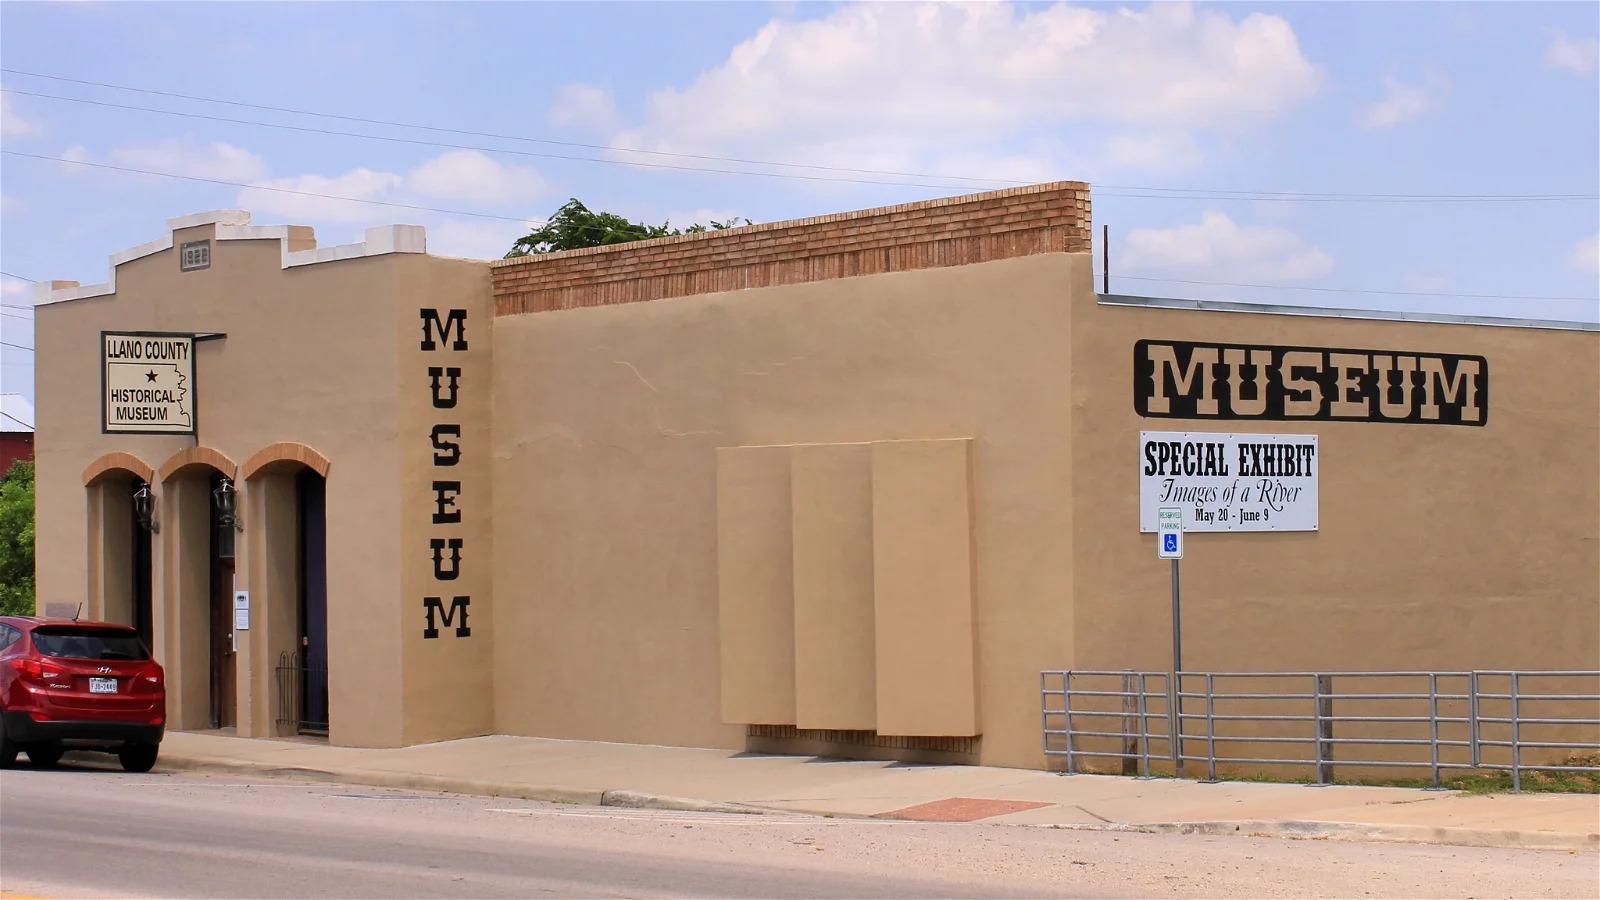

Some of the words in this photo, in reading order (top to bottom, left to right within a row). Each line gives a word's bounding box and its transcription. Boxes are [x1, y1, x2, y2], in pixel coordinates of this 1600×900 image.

[107, 340, 142, 359] LLANO
[145, 341, 189, 360] COUNTY
[1147, 344, 1480, 422] MUSEUM
[111, 388, 175, 403] HISTORICAL
[116, 406, 168, 421] MUSEUM
[1144, 441, 1229, 476] SPECIAL
[1238, 443, 1315, 477] EXHIBIT
[420, 308, 471, 639] MUSEUM
[1159, 478, 1218, 507] Images
[1222, 479, 1240, 508] of
[1240, 487, 1250, 503] a
[1256, 479, 1302, 512] River
[1161, 522, 1180, 530] PARKING
[1195, 508, 1215, 525] May
[1218, 508, 1229, 522] 20
[1239, 508, 1260, 525] June
[1263, 508, 1269, 521] 9
